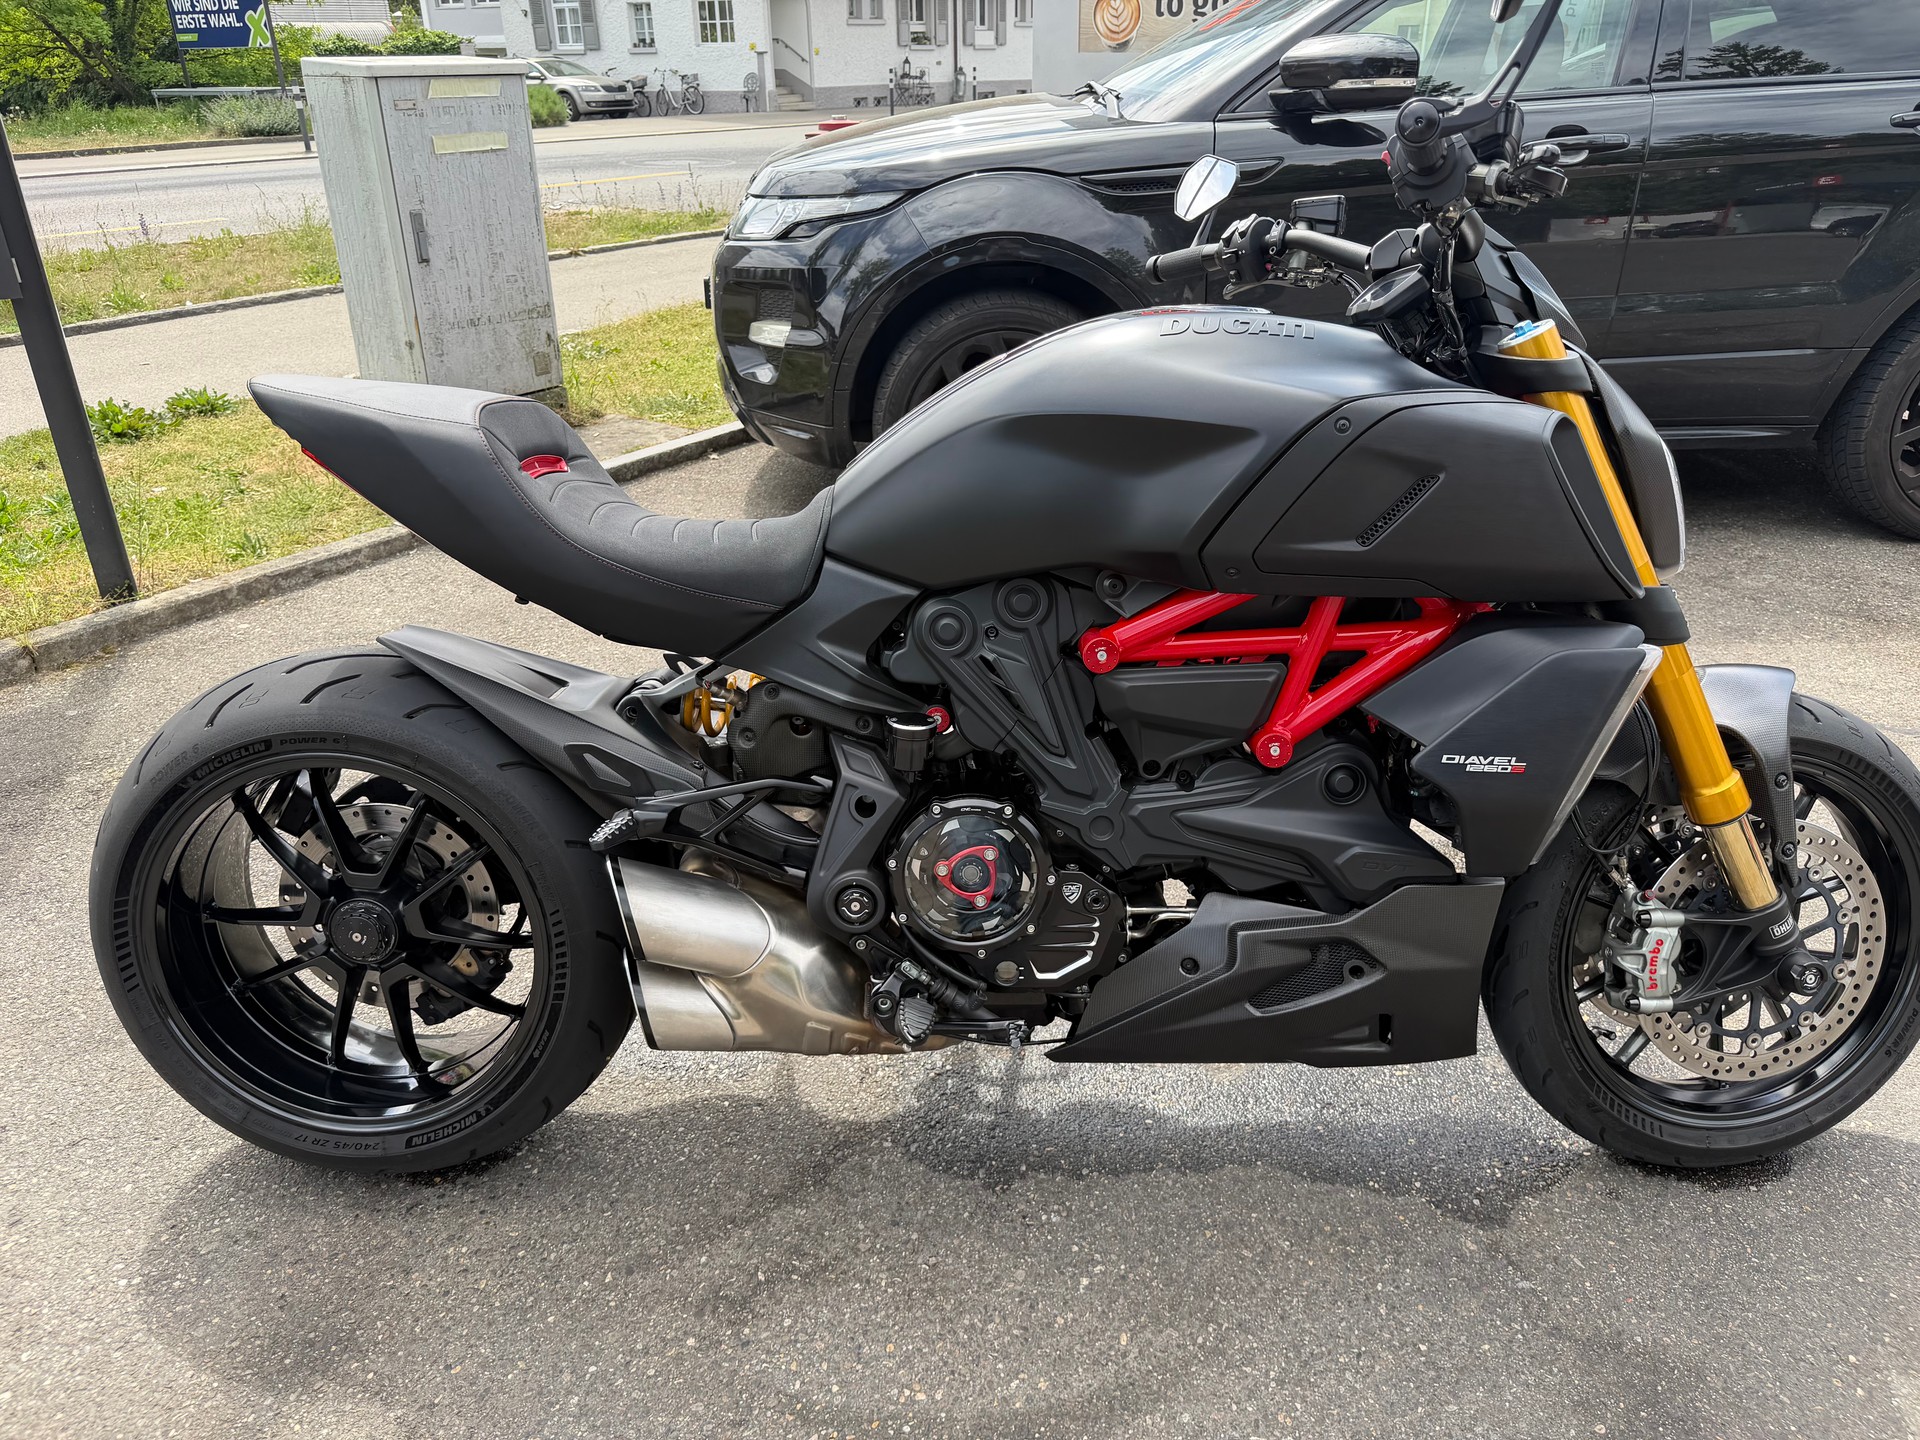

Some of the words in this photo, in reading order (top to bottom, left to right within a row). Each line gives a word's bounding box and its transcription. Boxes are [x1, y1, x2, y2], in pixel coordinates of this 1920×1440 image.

[171, 0, 193, 12] WIR
[194, 0, 219, 11] SIND
[222, 0, 240, 10] DIE
[1155, 0, 1184, 18] to
[175, 14, 207, 29] ERSTE
[207, 13, 243, 28] WAHL.
[1159, 316, 1316, 340] DUCATI
[280, 737, 328, 746] POWER
[196, 741, 267, 779] MICHELIN
[1441, 754, 1527, 766] DIAVEL
[1646, 938, 1664, 992] brembo
[1891, 1007, 1919, 1048] POWER
[411, 1112, 478, 1146] MICHELIN
[294, 1133, 309, 1143] 17
[311, 1137, 330, 1147] ZR
[332, 1140, 380, 1151] 240/45
